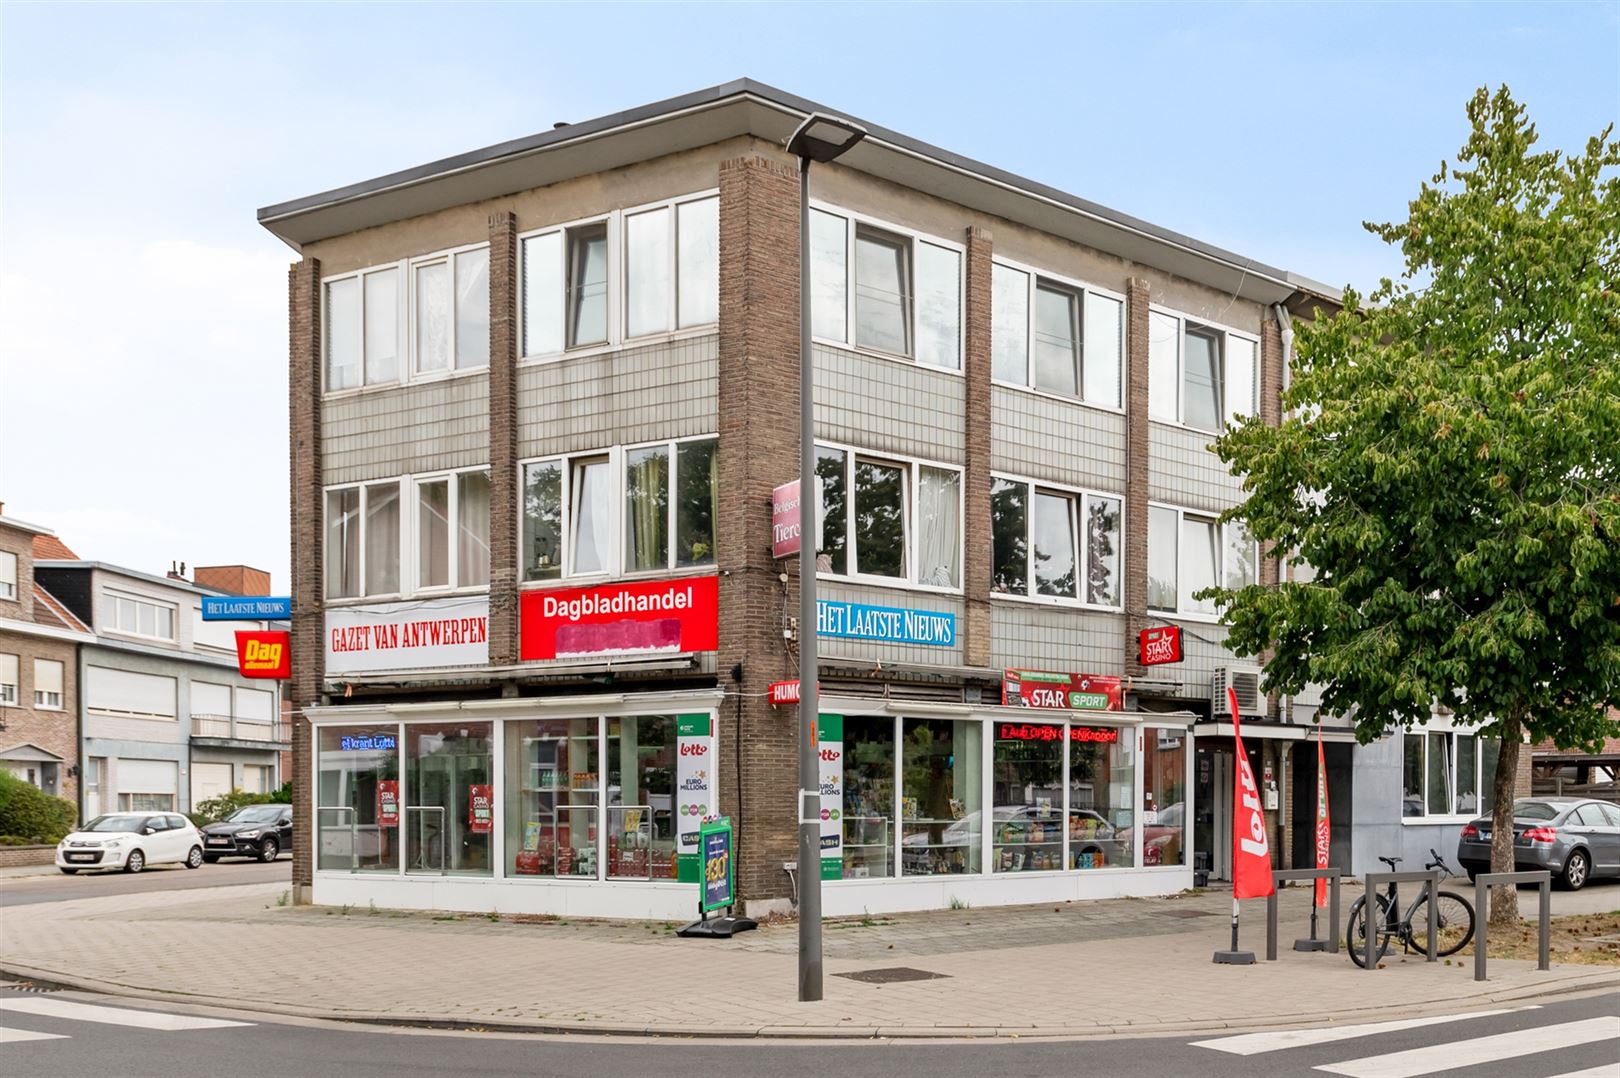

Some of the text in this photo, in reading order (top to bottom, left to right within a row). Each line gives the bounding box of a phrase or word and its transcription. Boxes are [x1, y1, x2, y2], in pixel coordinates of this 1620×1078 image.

[774, 523, 800, 544] Tierc
[207, 601, 284, 614] HET LAATSTE NIEUWS
[543, 586, 693, 621] Dagbladhandel
[816, 602, 952, 643] HET LAATSTE NIEUWS
[332, 616, 487, 653] GAZET VAN ANTWERPEN
[245, 639, 283, 669] Dag
[1146, 652, 1172, 663] CASINO
[1032, 689, 1106, 708] STAR SPORT
[680, 743, 707, 756] Lotto
[818, 749, 840, 761] tto
[682, 834, 699, 842] CAS
[820, 838, 839, 847] ASH
